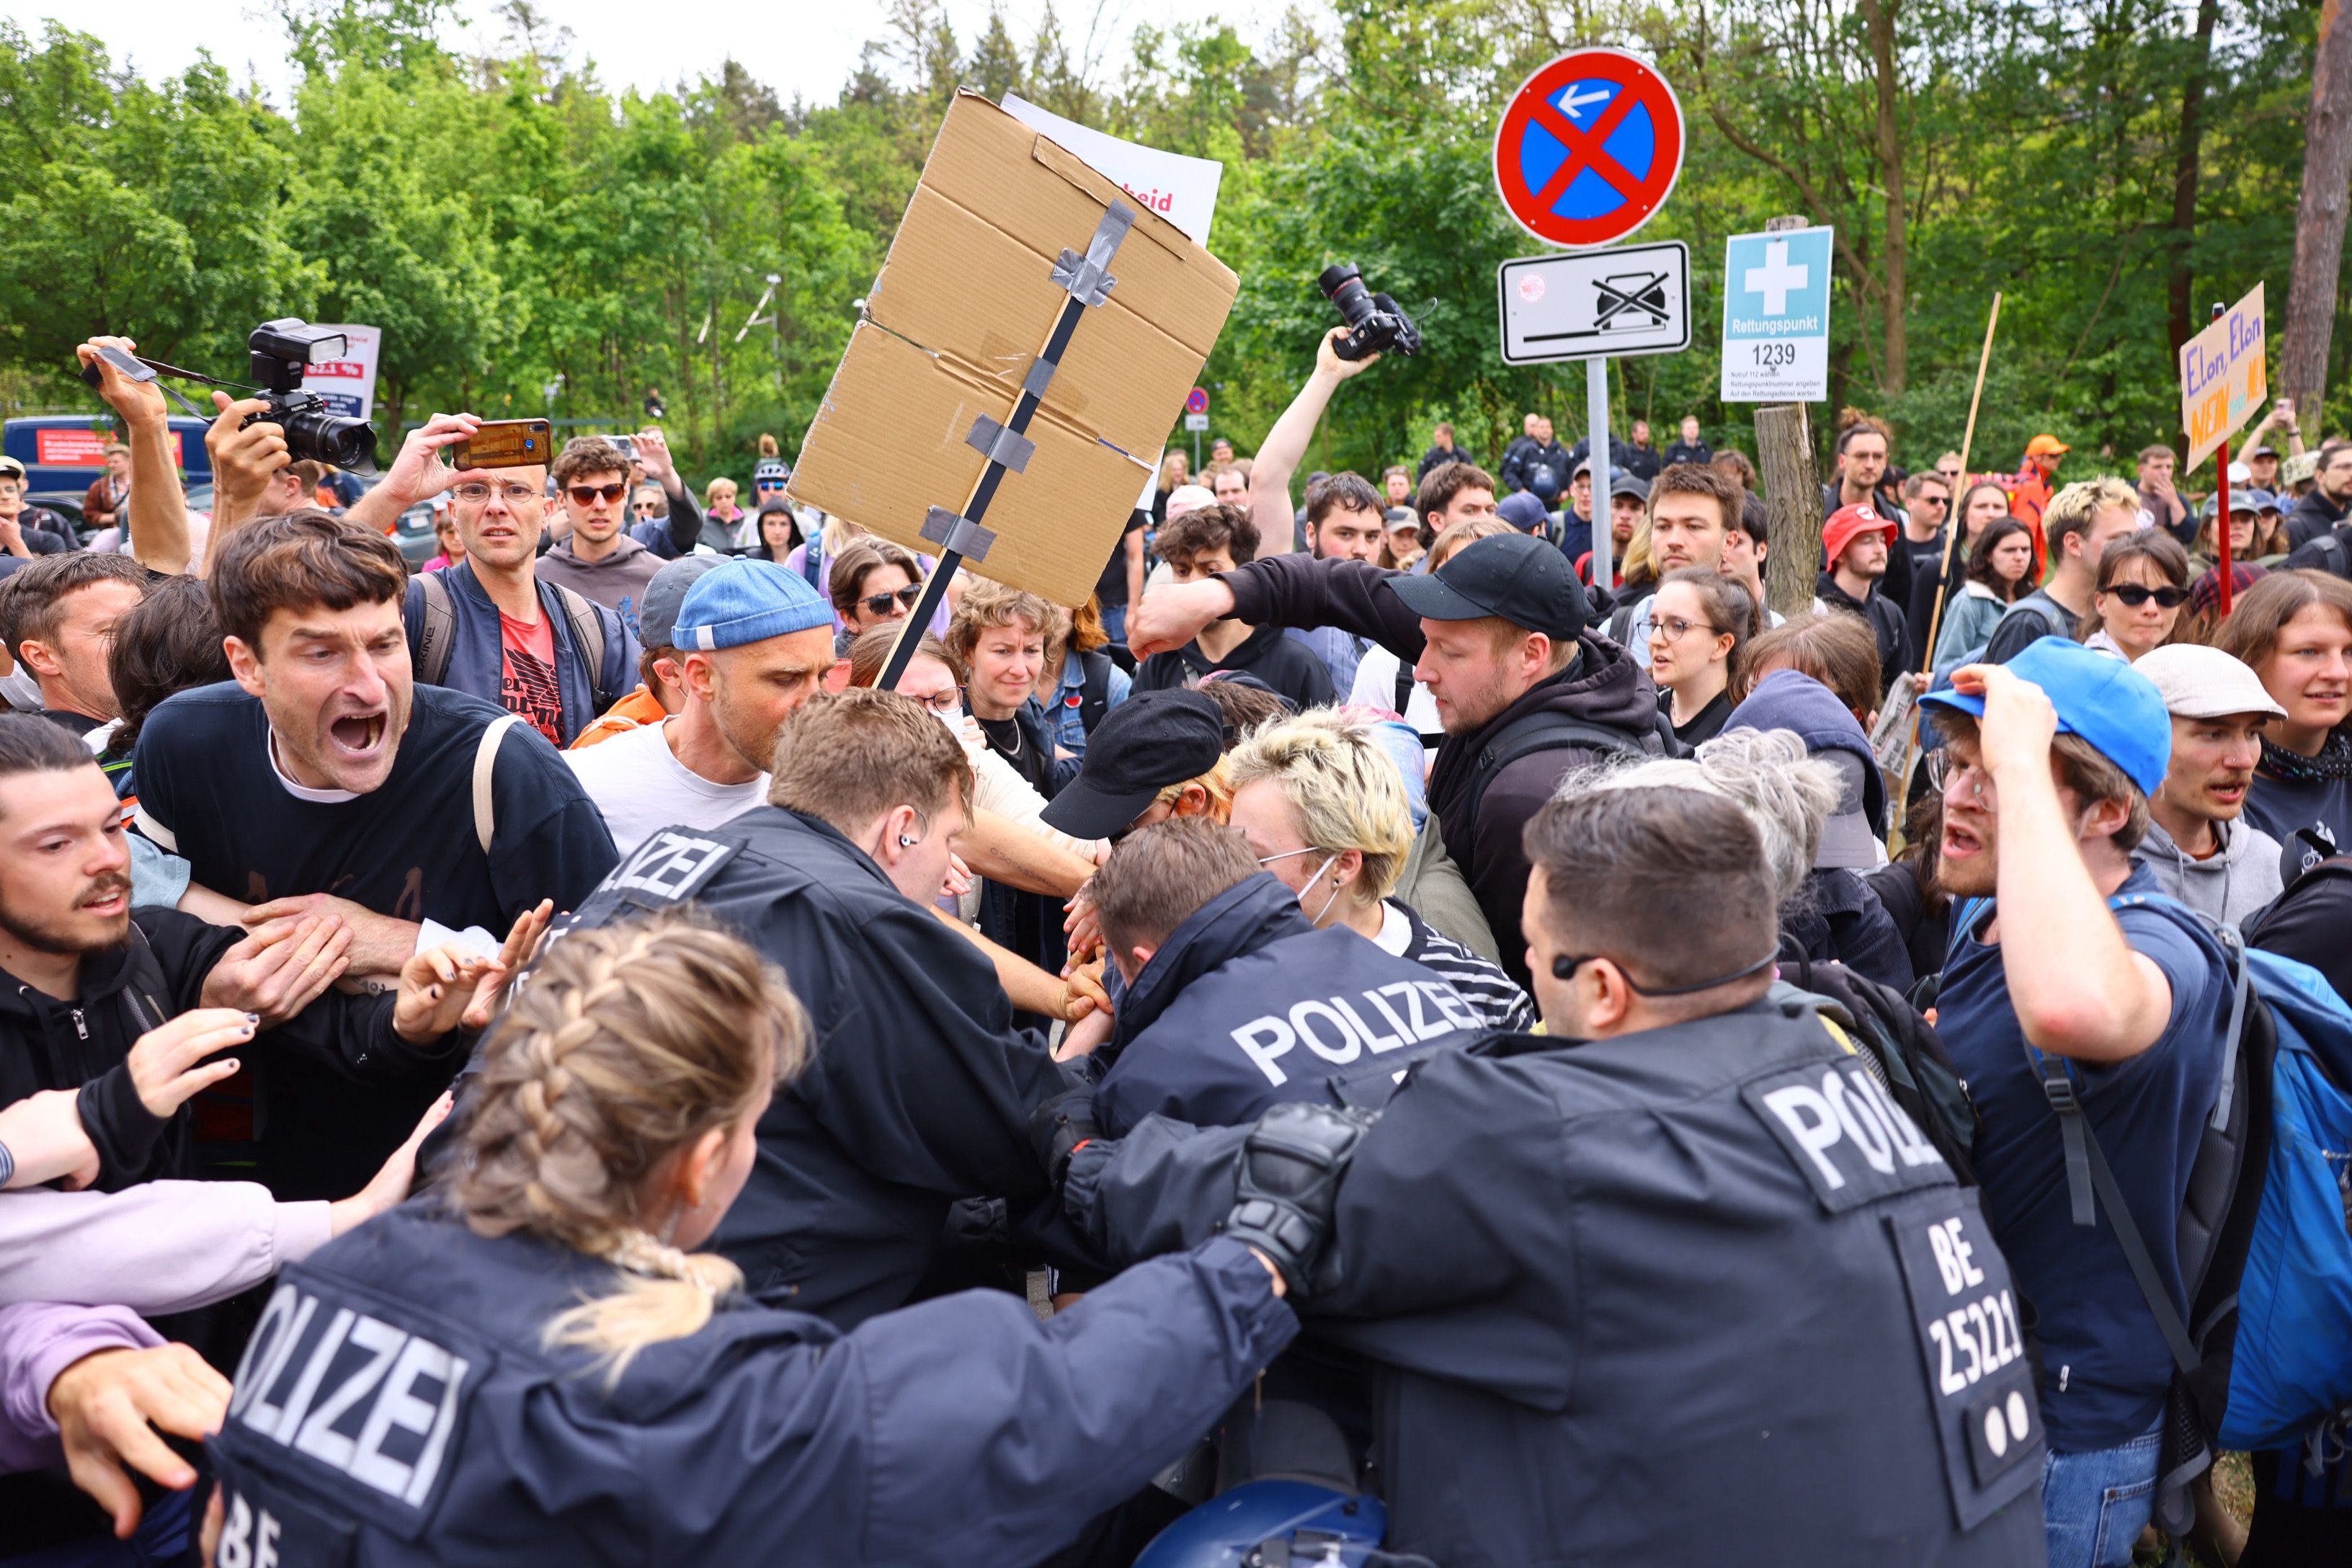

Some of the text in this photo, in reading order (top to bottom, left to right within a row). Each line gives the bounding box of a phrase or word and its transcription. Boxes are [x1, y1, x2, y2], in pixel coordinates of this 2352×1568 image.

[1732, 316, 1819, 335] Rettungspunkt
[1752, 344, 1796, 365] 1239
[2186, 311, 2261, 398] Elon, Elon
[1731, 380, 1794, 389] Rettungspunktnummer
[1752, 390, 1796, 398] Rettungsdienst
[2191, 381, 2230, 452] NEIN
[1928, 1217, 1984, 1296] BE
[1929, 1289, 2023, 1396] 25221
